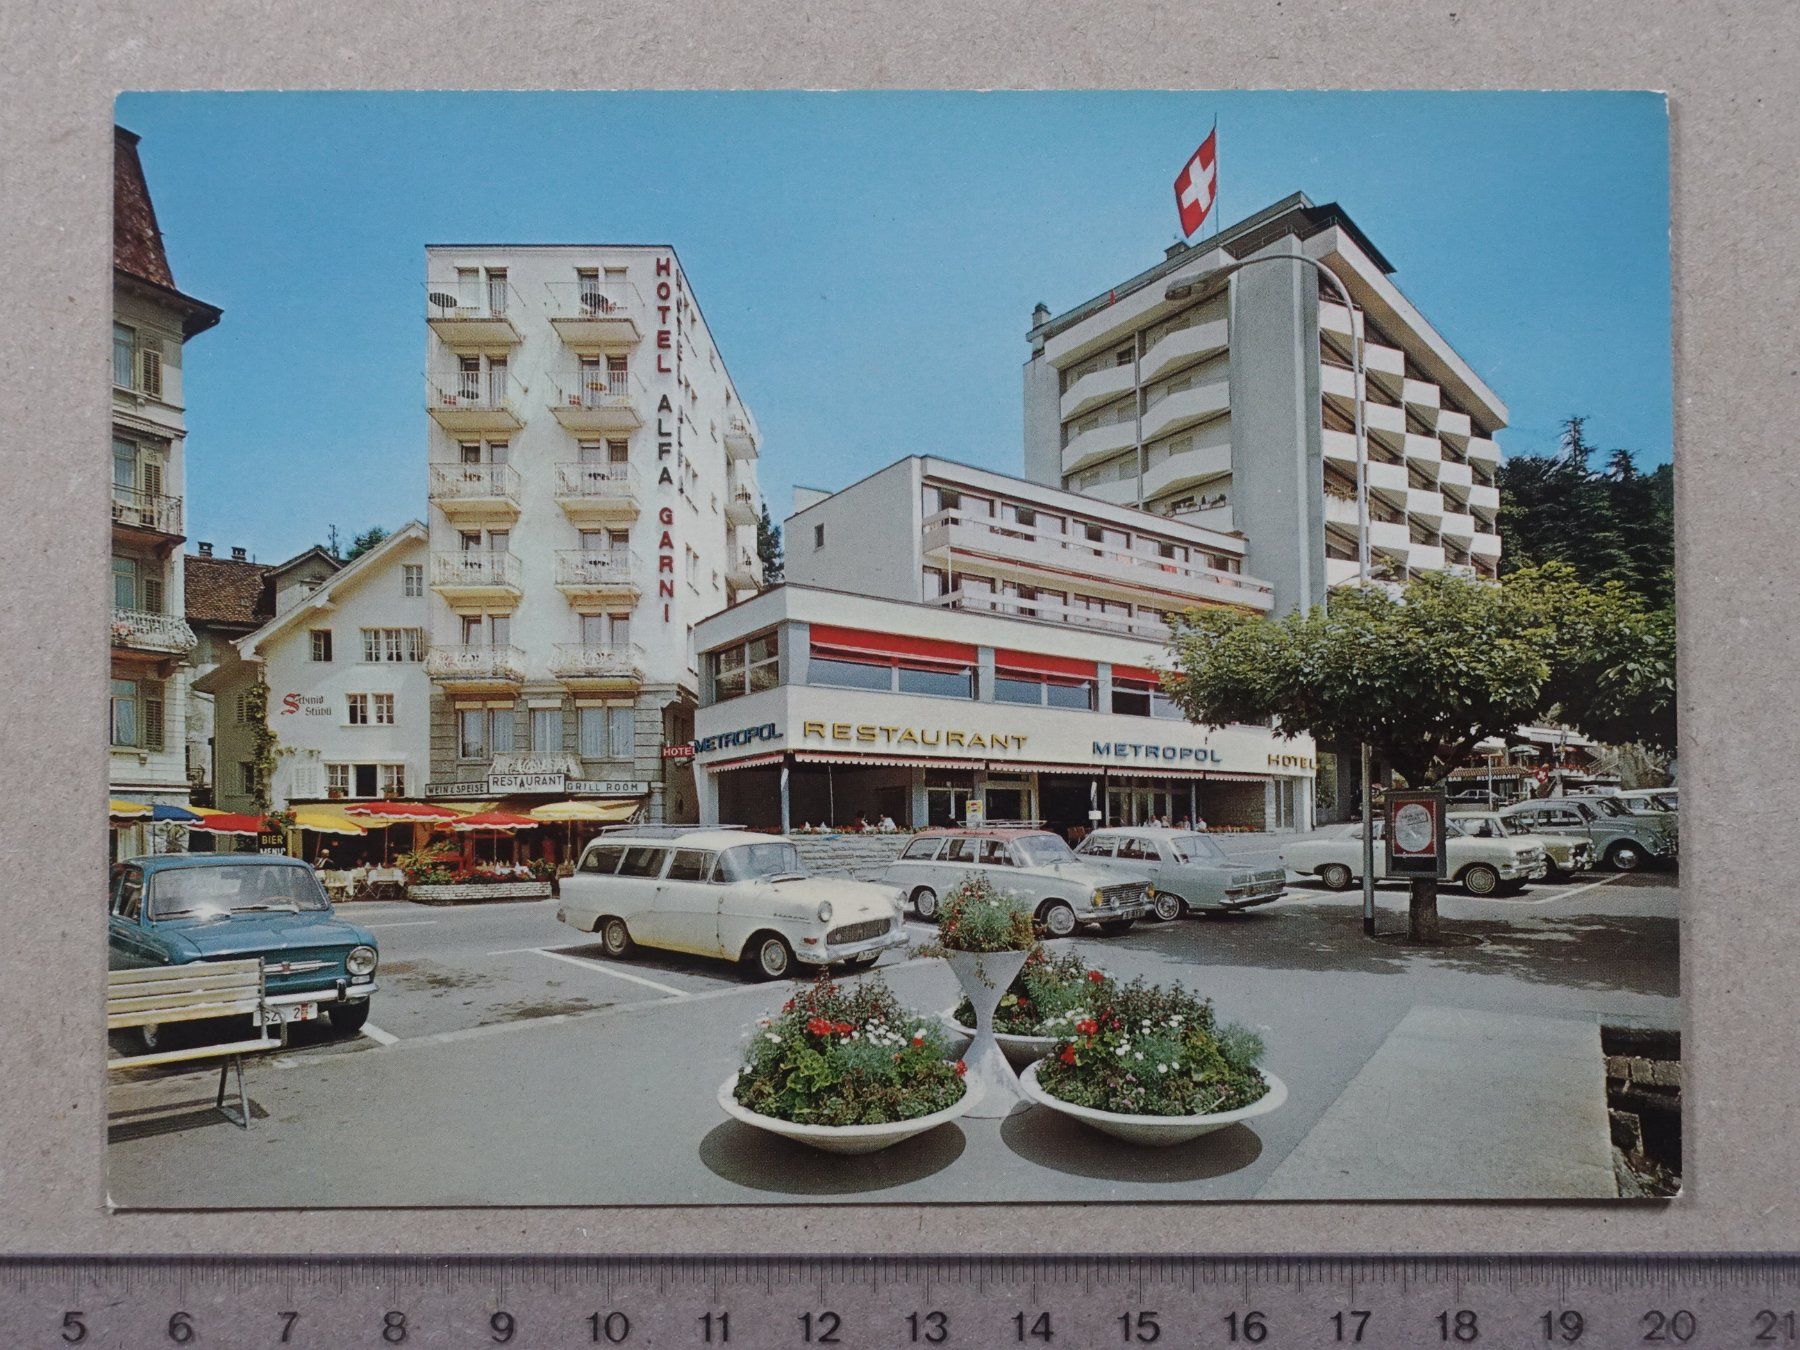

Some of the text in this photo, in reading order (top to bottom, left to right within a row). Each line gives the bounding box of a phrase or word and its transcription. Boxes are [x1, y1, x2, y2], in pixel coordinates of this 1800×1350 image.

[656, 257, 674, 623] HOTEL ALFA GARNI
[694, 722, 784, 754] METROPOL
[803, 720, 1029, 750] RESTAURANT
[1092, 740, 1223, 764] METROPOL
[1267, 753, 1318, 770] HOTEL
[428, 785, 449, 795] WEIN
[456, 783, 485, 793] SPEISE
[492, 775, 563, 788] RESTAURANT
[567, 782, 638, 792] GRILL ROOM
[261, 835, 284, 845] BIER
[61, 1309, 1796, 1343] 5 6 7 8 9 10 11 12 13 14 15 16 17 18 19 20 21
